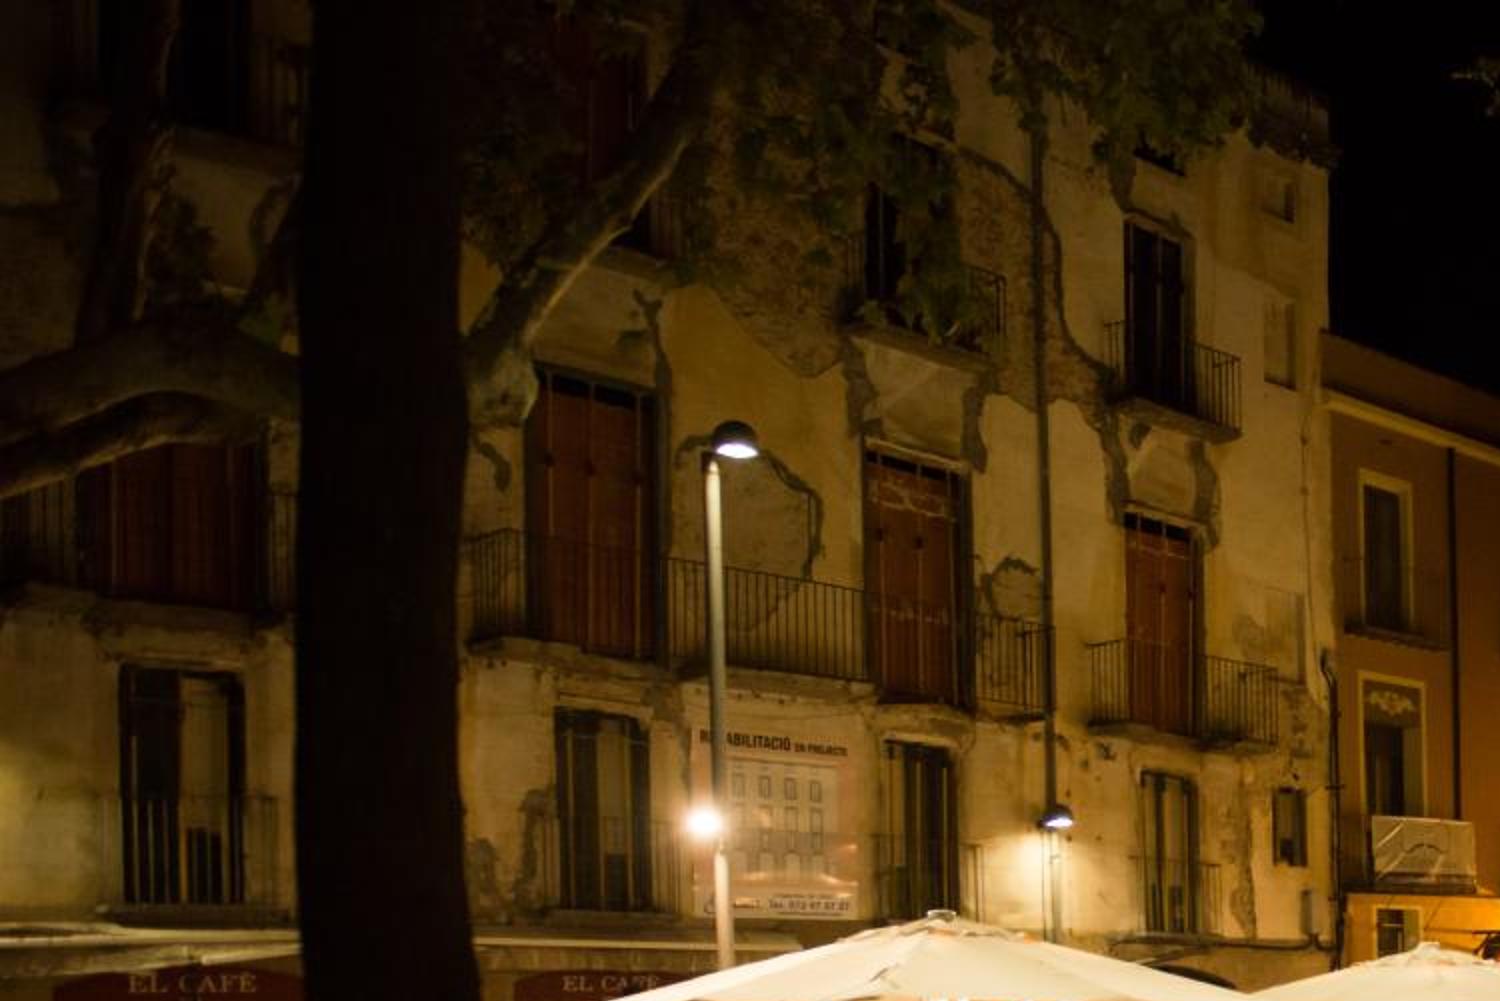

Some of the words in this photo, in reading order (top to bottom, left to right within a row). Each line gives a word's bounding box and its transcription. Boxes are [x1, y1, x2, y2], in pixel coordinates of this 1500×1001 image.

[699, 729, 791, 751] RABILITACIÓ
[129, 975, 169, 993] EL
[562, 975, 593, 991] EL
